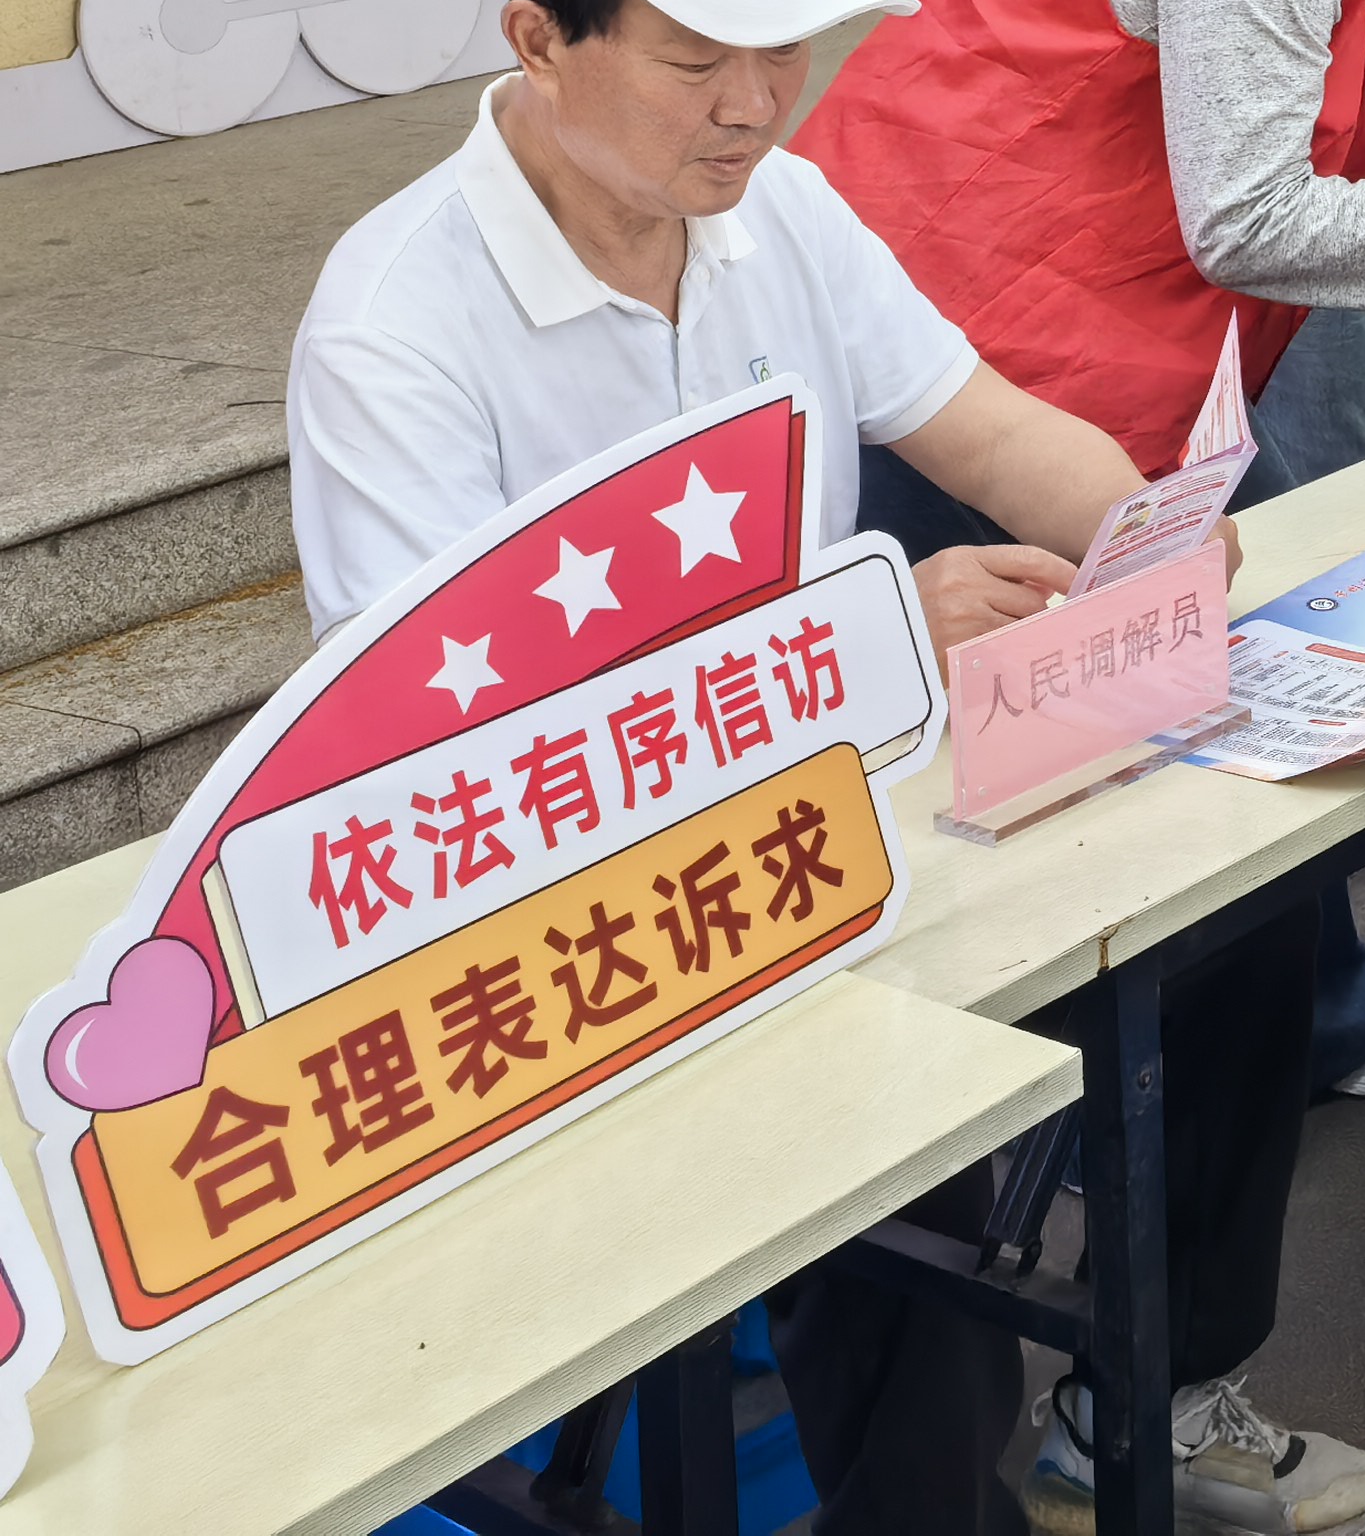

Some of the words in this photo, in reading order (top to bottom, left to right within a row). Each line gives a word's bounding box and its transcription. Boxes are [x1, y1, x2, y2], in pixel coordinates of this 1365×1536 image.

[307, 615, 848, 950] 依法有序信访
[977, 590, 1203, 737] 人民调解员
[169, 799, 847, 1240] 合理表达诉求
